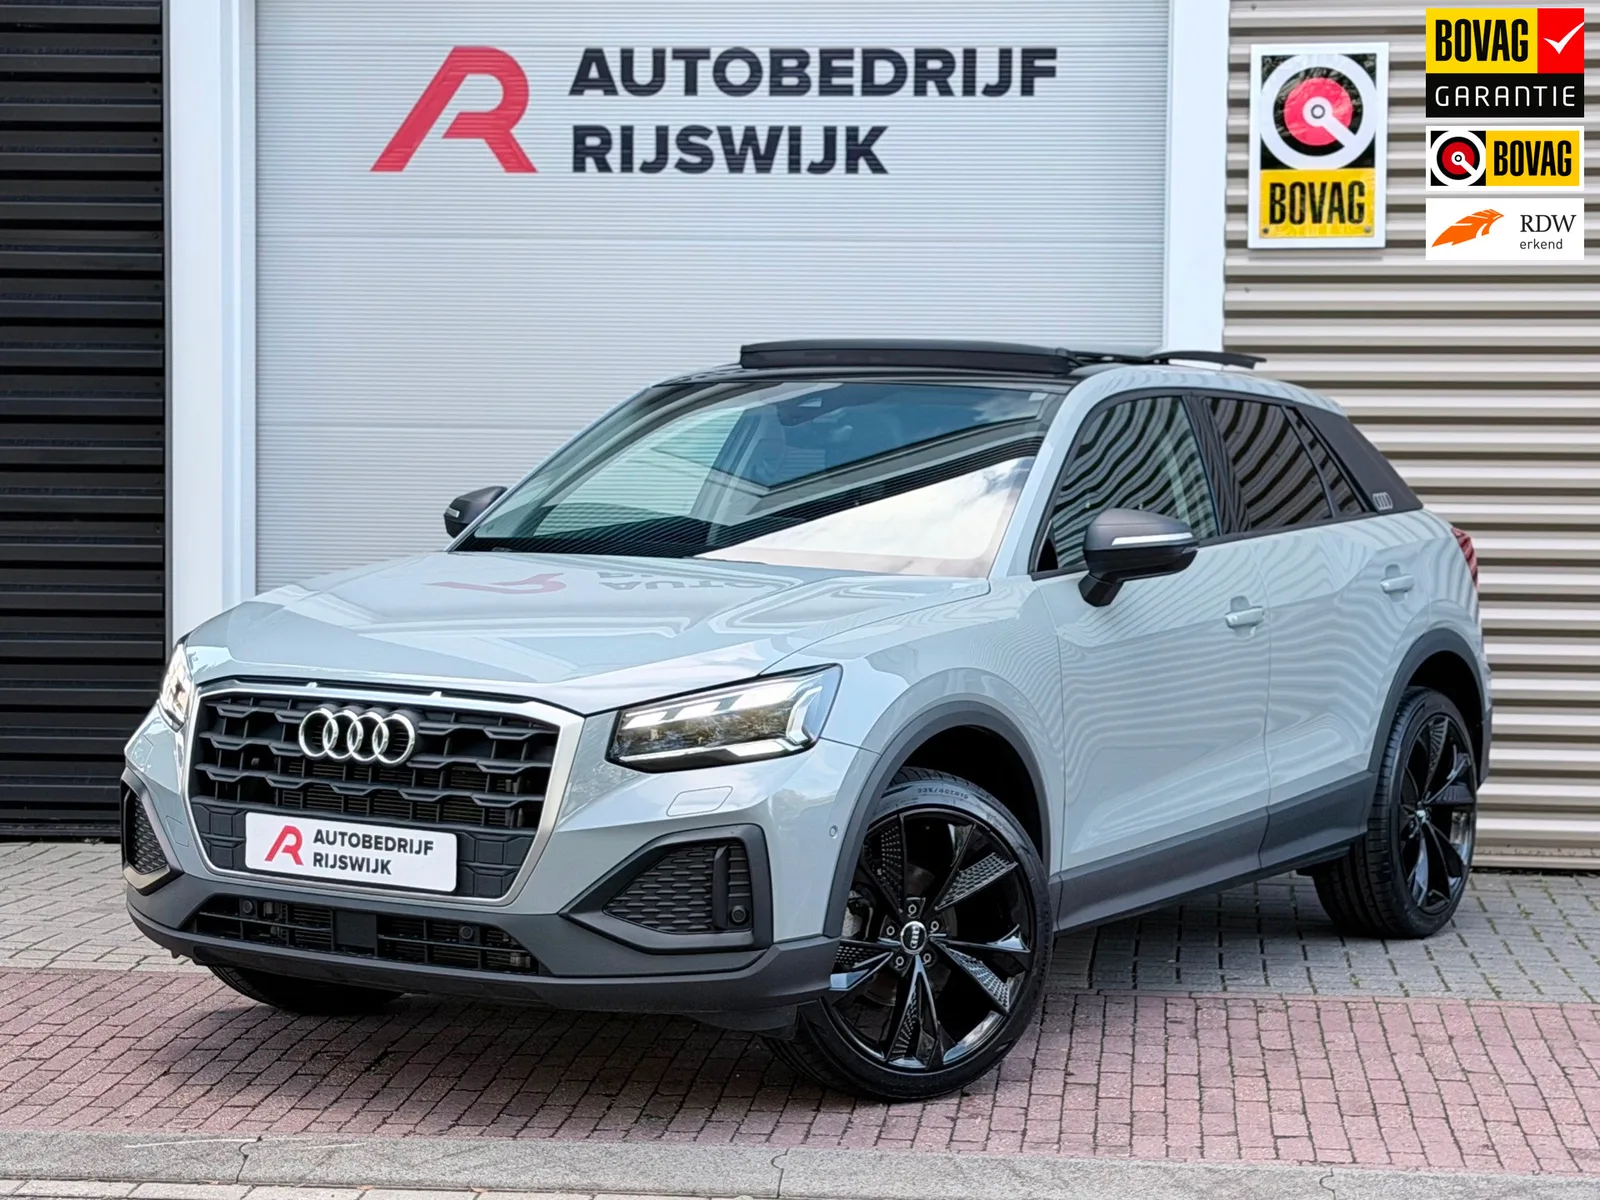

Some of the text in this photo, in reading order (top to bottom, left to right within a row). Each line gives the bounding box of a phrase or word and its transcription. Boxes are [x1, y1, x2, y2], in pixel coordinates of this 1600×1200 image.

[569, 46, 1058, 98] AUTOBEDRIJF
[572, 124, 888, 175] RIJSWIJK
[1269, 180, 1365, 225] BOVAG
[313, 829, 434, 856] AUTOBEDRIJF
[313, 852, 392, 875] RIJSWIJK
